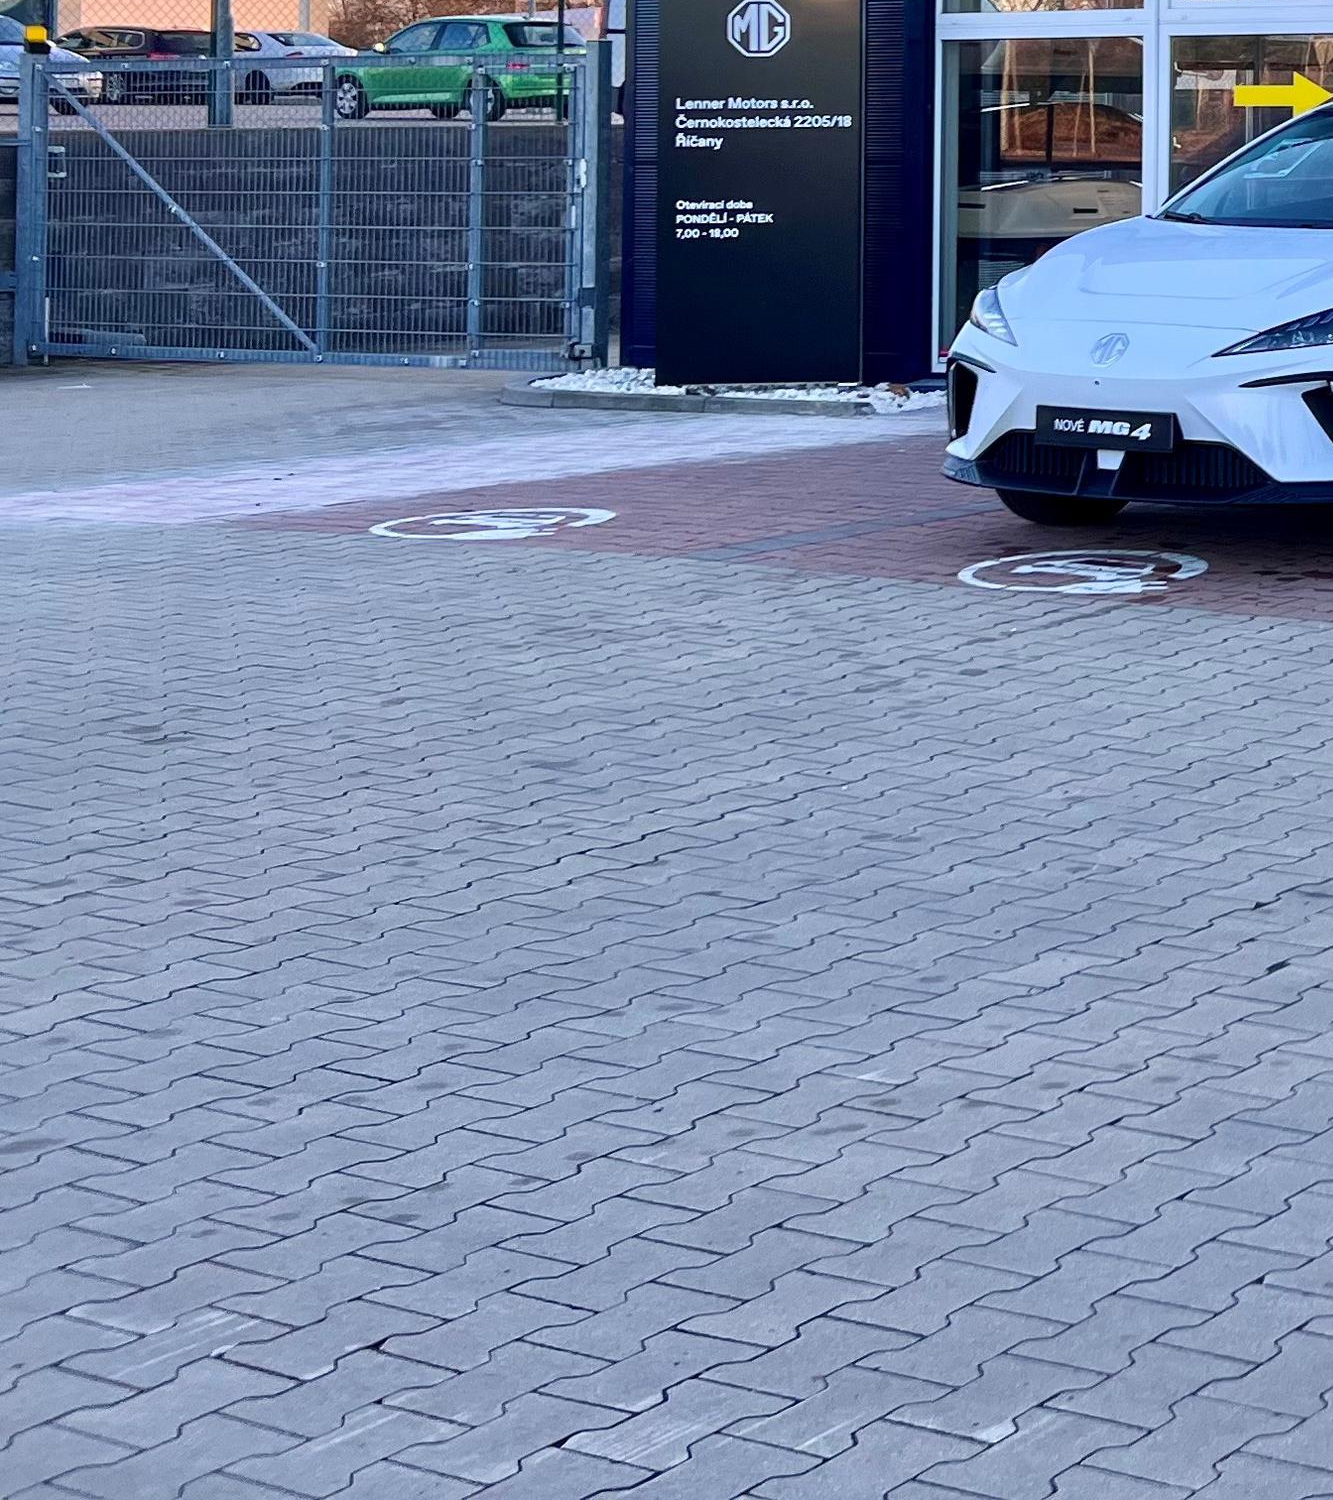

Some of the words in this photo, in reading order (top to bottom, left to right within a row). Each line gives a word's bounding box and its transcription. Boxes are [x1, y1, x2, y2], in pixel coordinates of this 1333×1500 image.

[730, 1, 788, 54] MG
[675, 97, 726, 110] Lenner
[728, 97, 778, 110] Motors
[780, 99, 815, 109] s.r.o.
[675, 114, 791, 129] Černokostelecká
[793, 115, 853, 128] 2205/18
[675, 133, 724, 150] Říčany
[675, 200, 724, 210] Otevírací
[726, 200, 753, 210] doba
[675, 212, 727, 224] PONDĚLÍ
[736, 212, 774, 223] PÁTEK
[675, 228, 700, 239] 7,00
[1091, 334, 1128, 366] MG
[1054, 418, 1085, 433] NOVÉ
